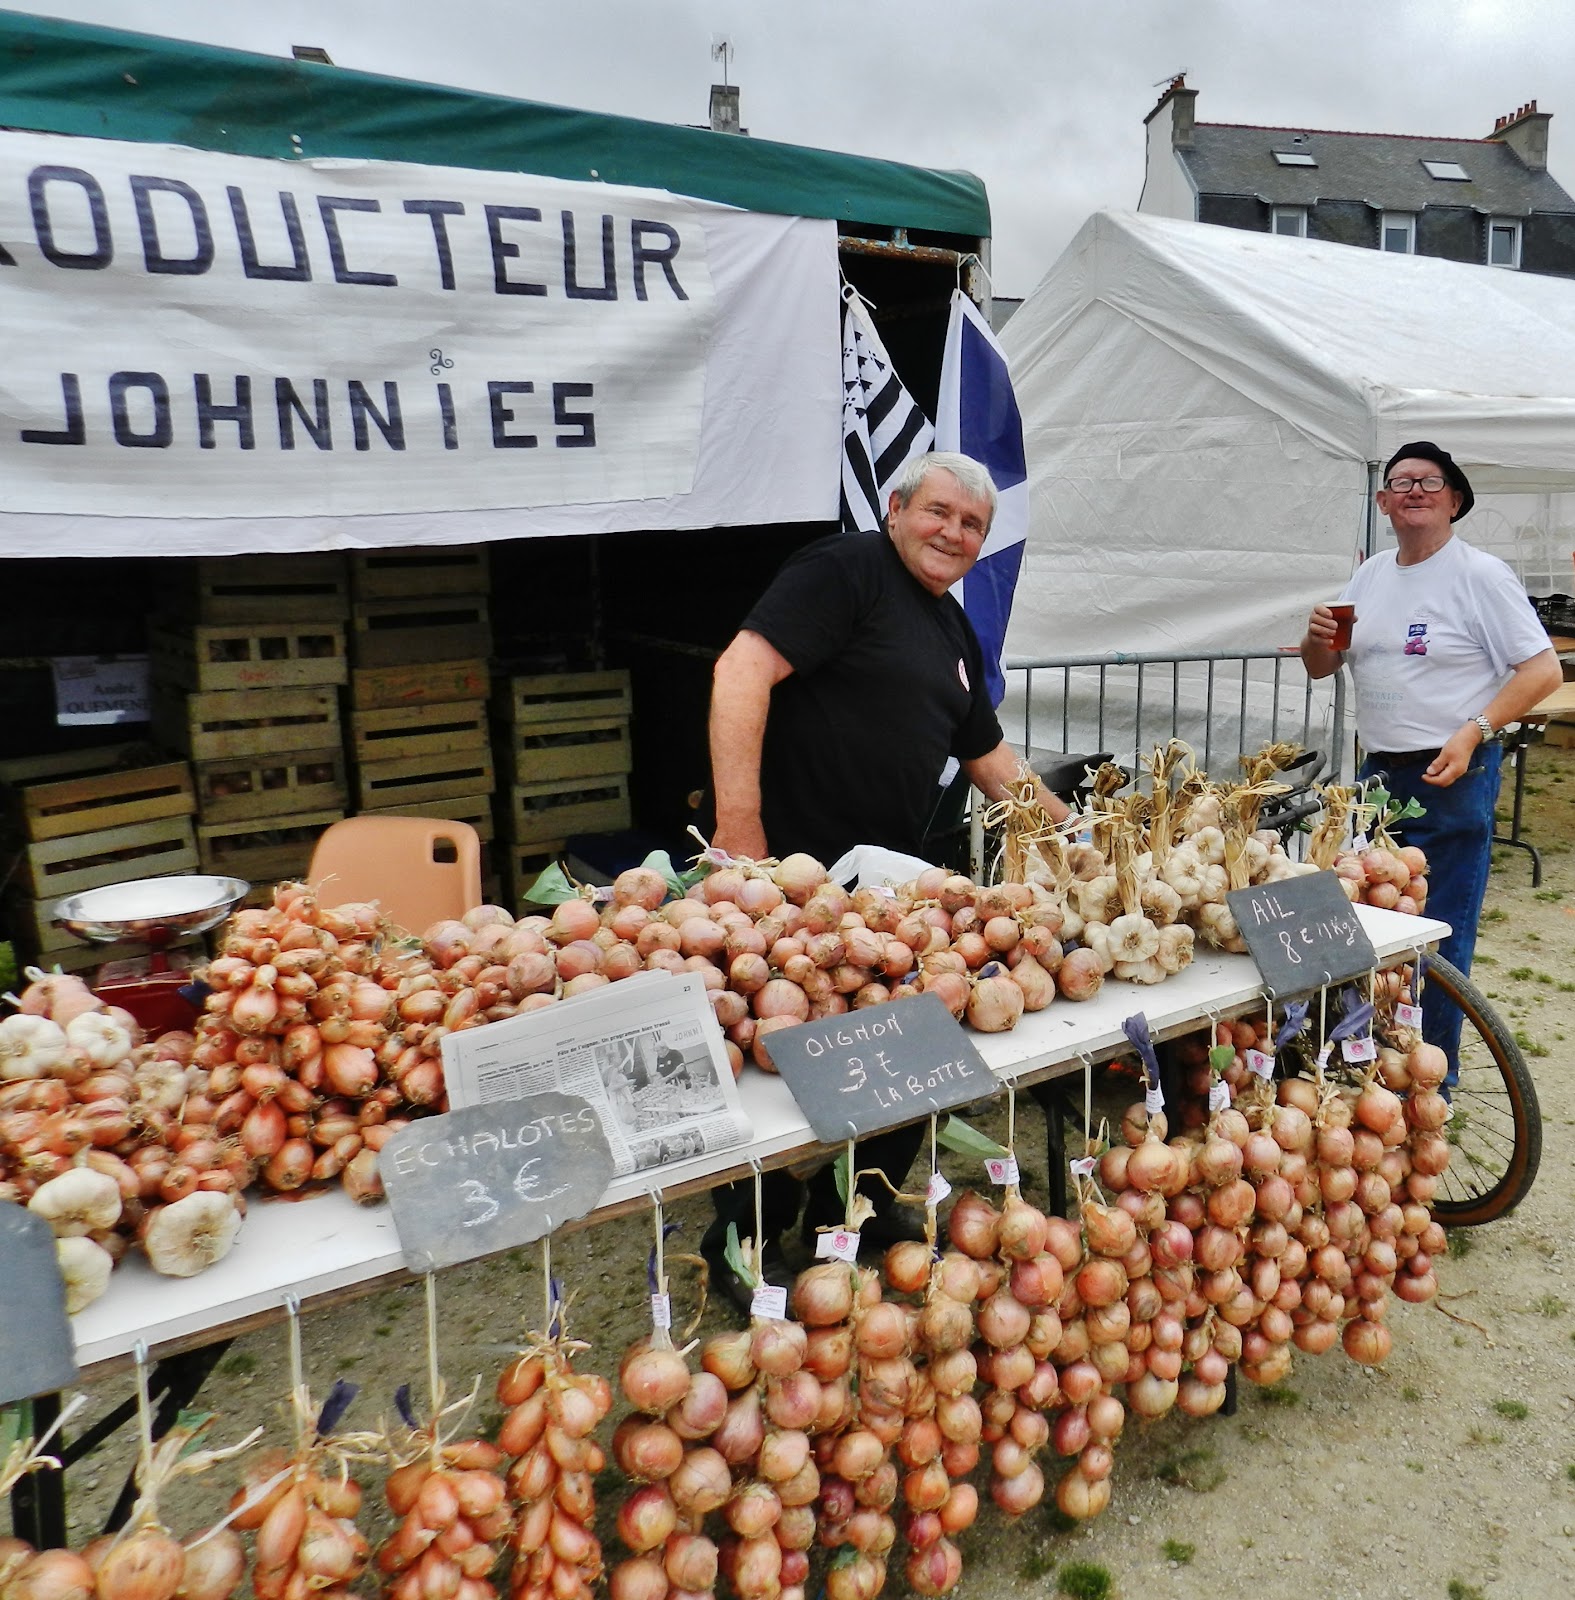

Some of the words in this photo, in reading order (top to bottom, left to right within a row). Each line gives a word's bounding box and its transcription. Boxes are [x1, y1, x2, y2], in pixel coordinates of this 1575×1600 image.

[0, 165, 690, 302] ODUCTEUR
[21, 371, 596, 451] JOHNNIES
[805, 1013, 903, 1057] OIGNON
[839, 1057, 867, 1093] 3
[874, 1087, 903, 1108] LA
[393, 1107, 595, 1175] ECHALOTES
[459, 1179, 499, 1228] 3
